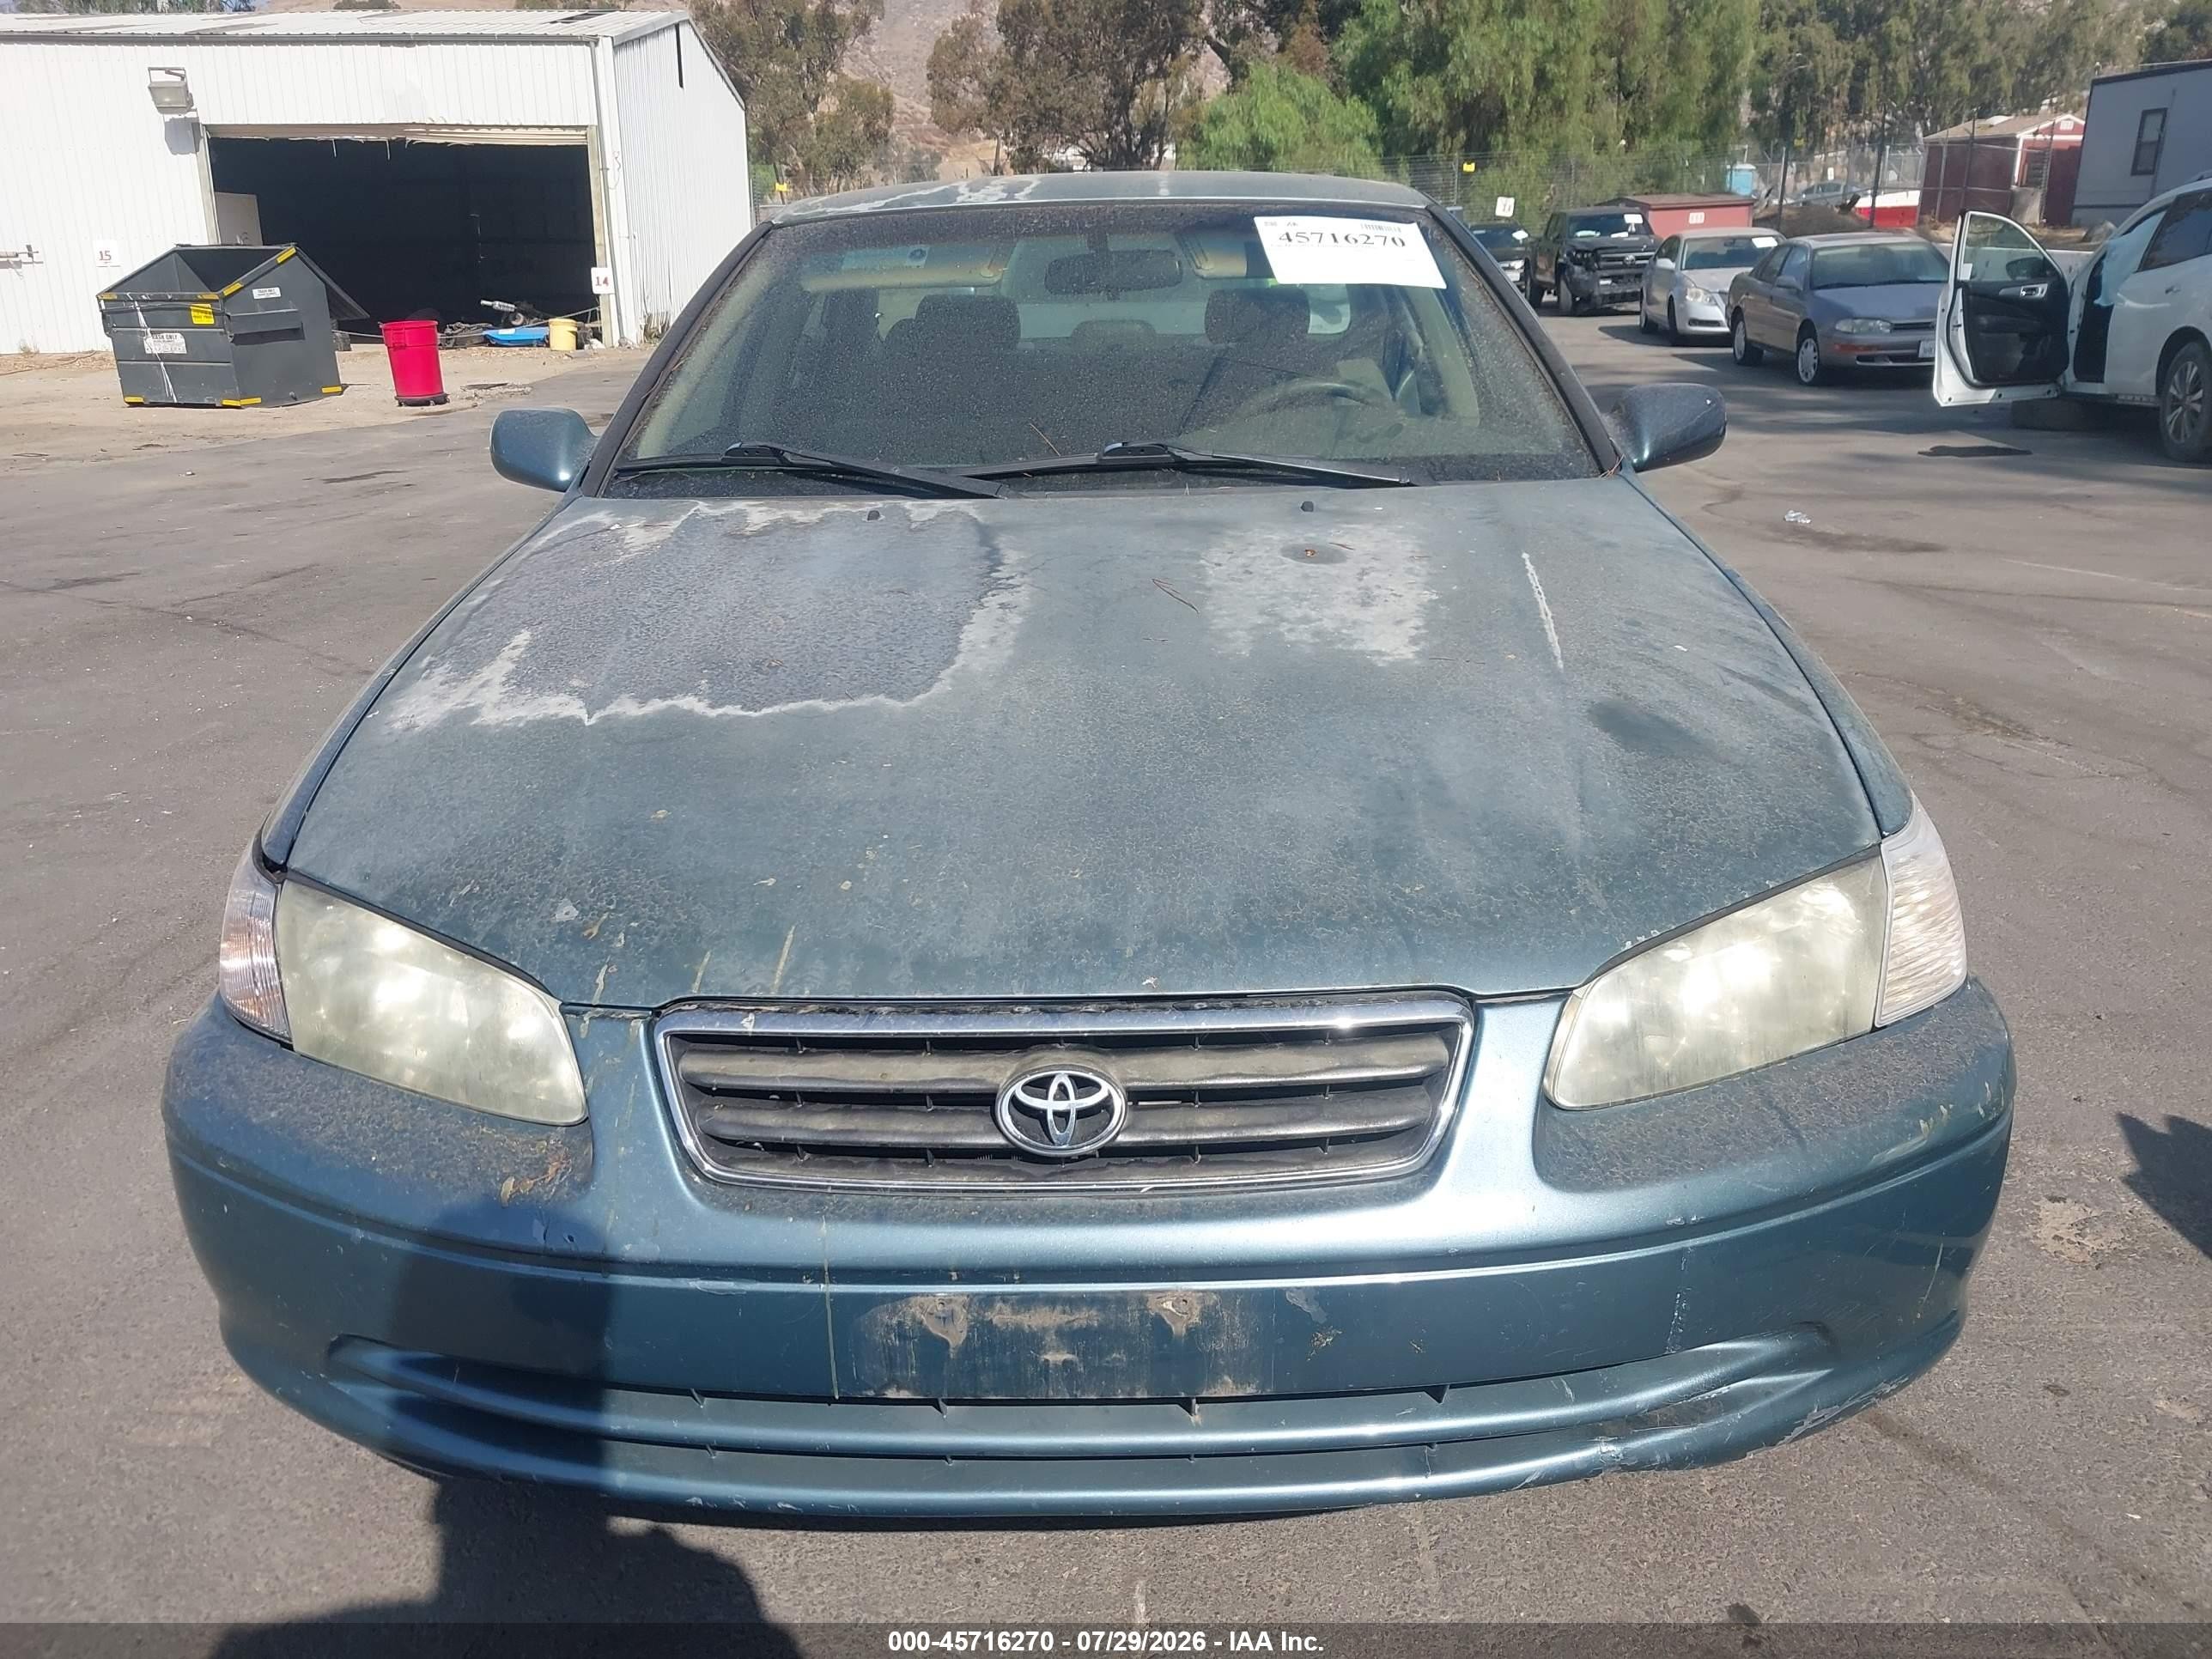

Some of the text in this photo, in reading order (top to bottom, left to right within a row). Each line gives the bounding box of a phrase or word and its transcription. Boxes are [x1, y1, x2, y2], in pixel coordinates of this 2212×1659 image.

[1279, 231, 1407, 247] 45716270
[99, 250, 112, 261] 15
[595, 276, 610, 287] 14
